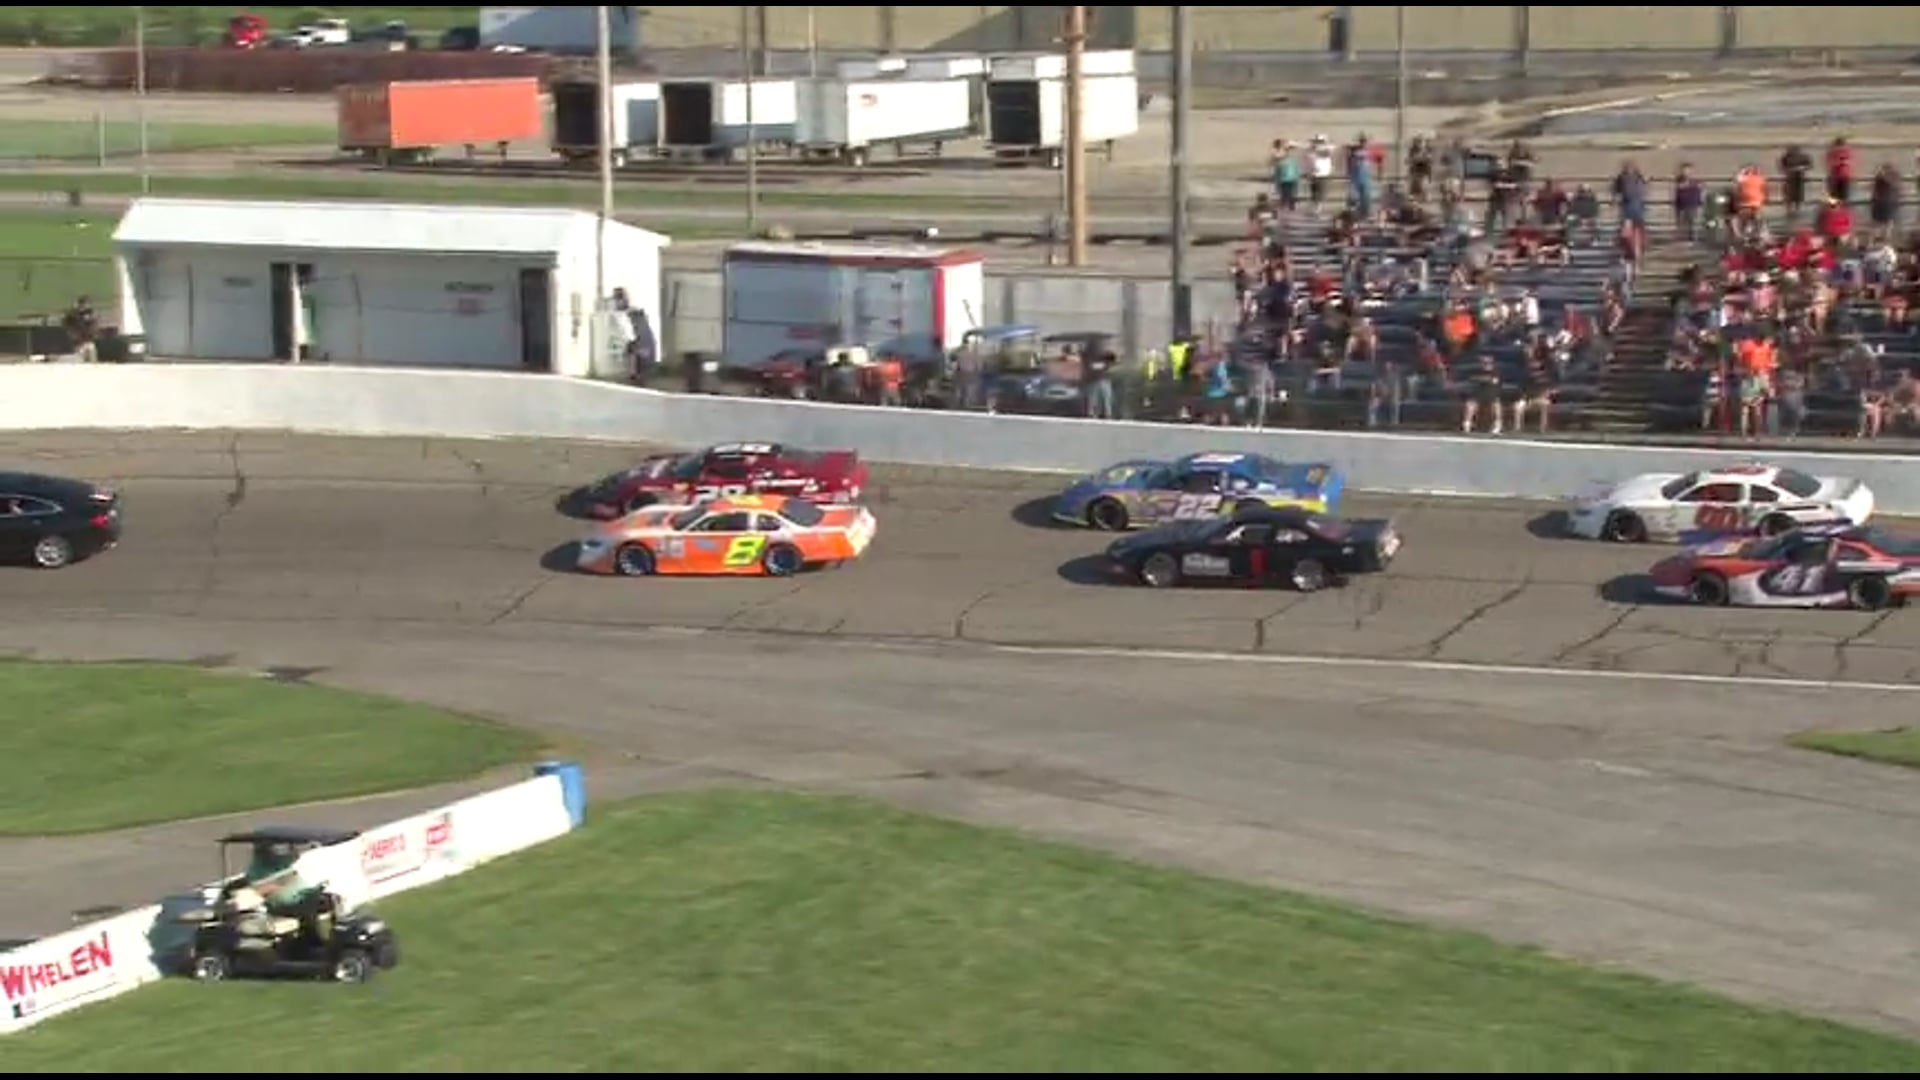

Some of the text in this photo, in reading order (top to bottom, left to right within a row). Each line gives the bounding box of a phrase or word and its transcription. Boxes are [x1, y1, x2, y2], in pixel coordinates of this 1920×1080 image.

[1175, 494, 1222, 519] 22
[724, 536, 766, 565] 8
[1770, 565, 1824, 591] 41
[0, 931, 112, 1001] WHELEN
